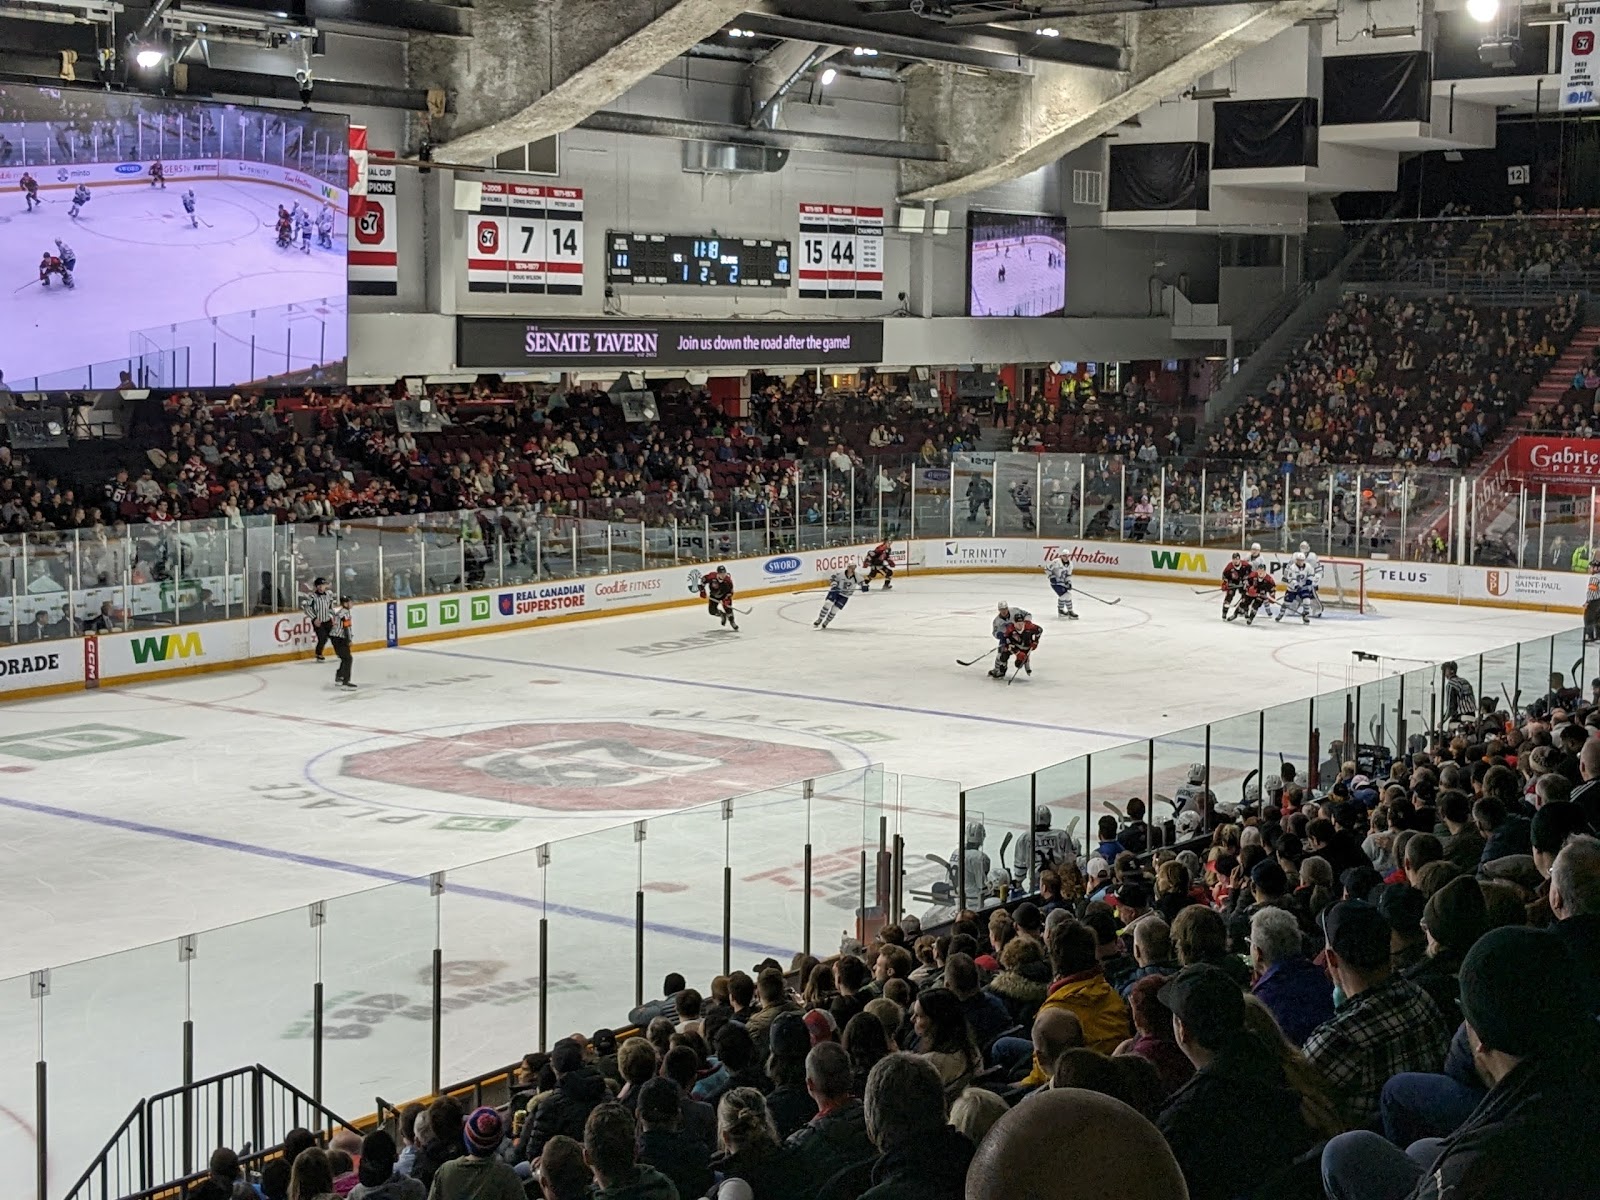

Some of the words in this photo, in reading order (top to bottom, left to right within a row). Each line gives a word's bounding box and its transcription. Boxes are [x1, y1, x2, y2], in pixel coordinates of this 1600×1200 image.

[1510, 170, 1522, 181] 12
[368, 182, 393, 193] PIONS
[521, 226, 534, 254] 7
[553, 228, 577, 256] 14
[805, 240, 823, 264] 15
[831, 240, 854, 264] 44
[525, 332, 590, 353] SENATE
[594, 333, 658, 353] TAVERN
[677, 335, 698, 350] Join
[700, 338, 712, 350] us
[714, 335, 742, 350] down
[743, 335, 759, 350] the
[761, 335, 782, 350] road
[784, 335, 805, 350] after
[806, 335, 822, 349] the
[822, 335, 850, 352] game!
[1530, 444, 1600, 467] Gabrie
[961, 548, 1007, 558] TRINITY
[1070, 546, 1119, 566] Hortons
[1151, 550, 1208, 572] WM
[768, 560, 797, 571] SWORD
[1379, 570, 1428, 582] TELUS
[516, 590, 538, 601] REAL
[540, 584, 585, 598] CANADIAN
[595, 580, 628, 596] GoodLife
[630, 579, 661, 591] FITNESS
[516, 595, 585, 614] SUPERSTORE
[130, 632, 204, 664] WM
[87, 640, 95, 680] CCM
